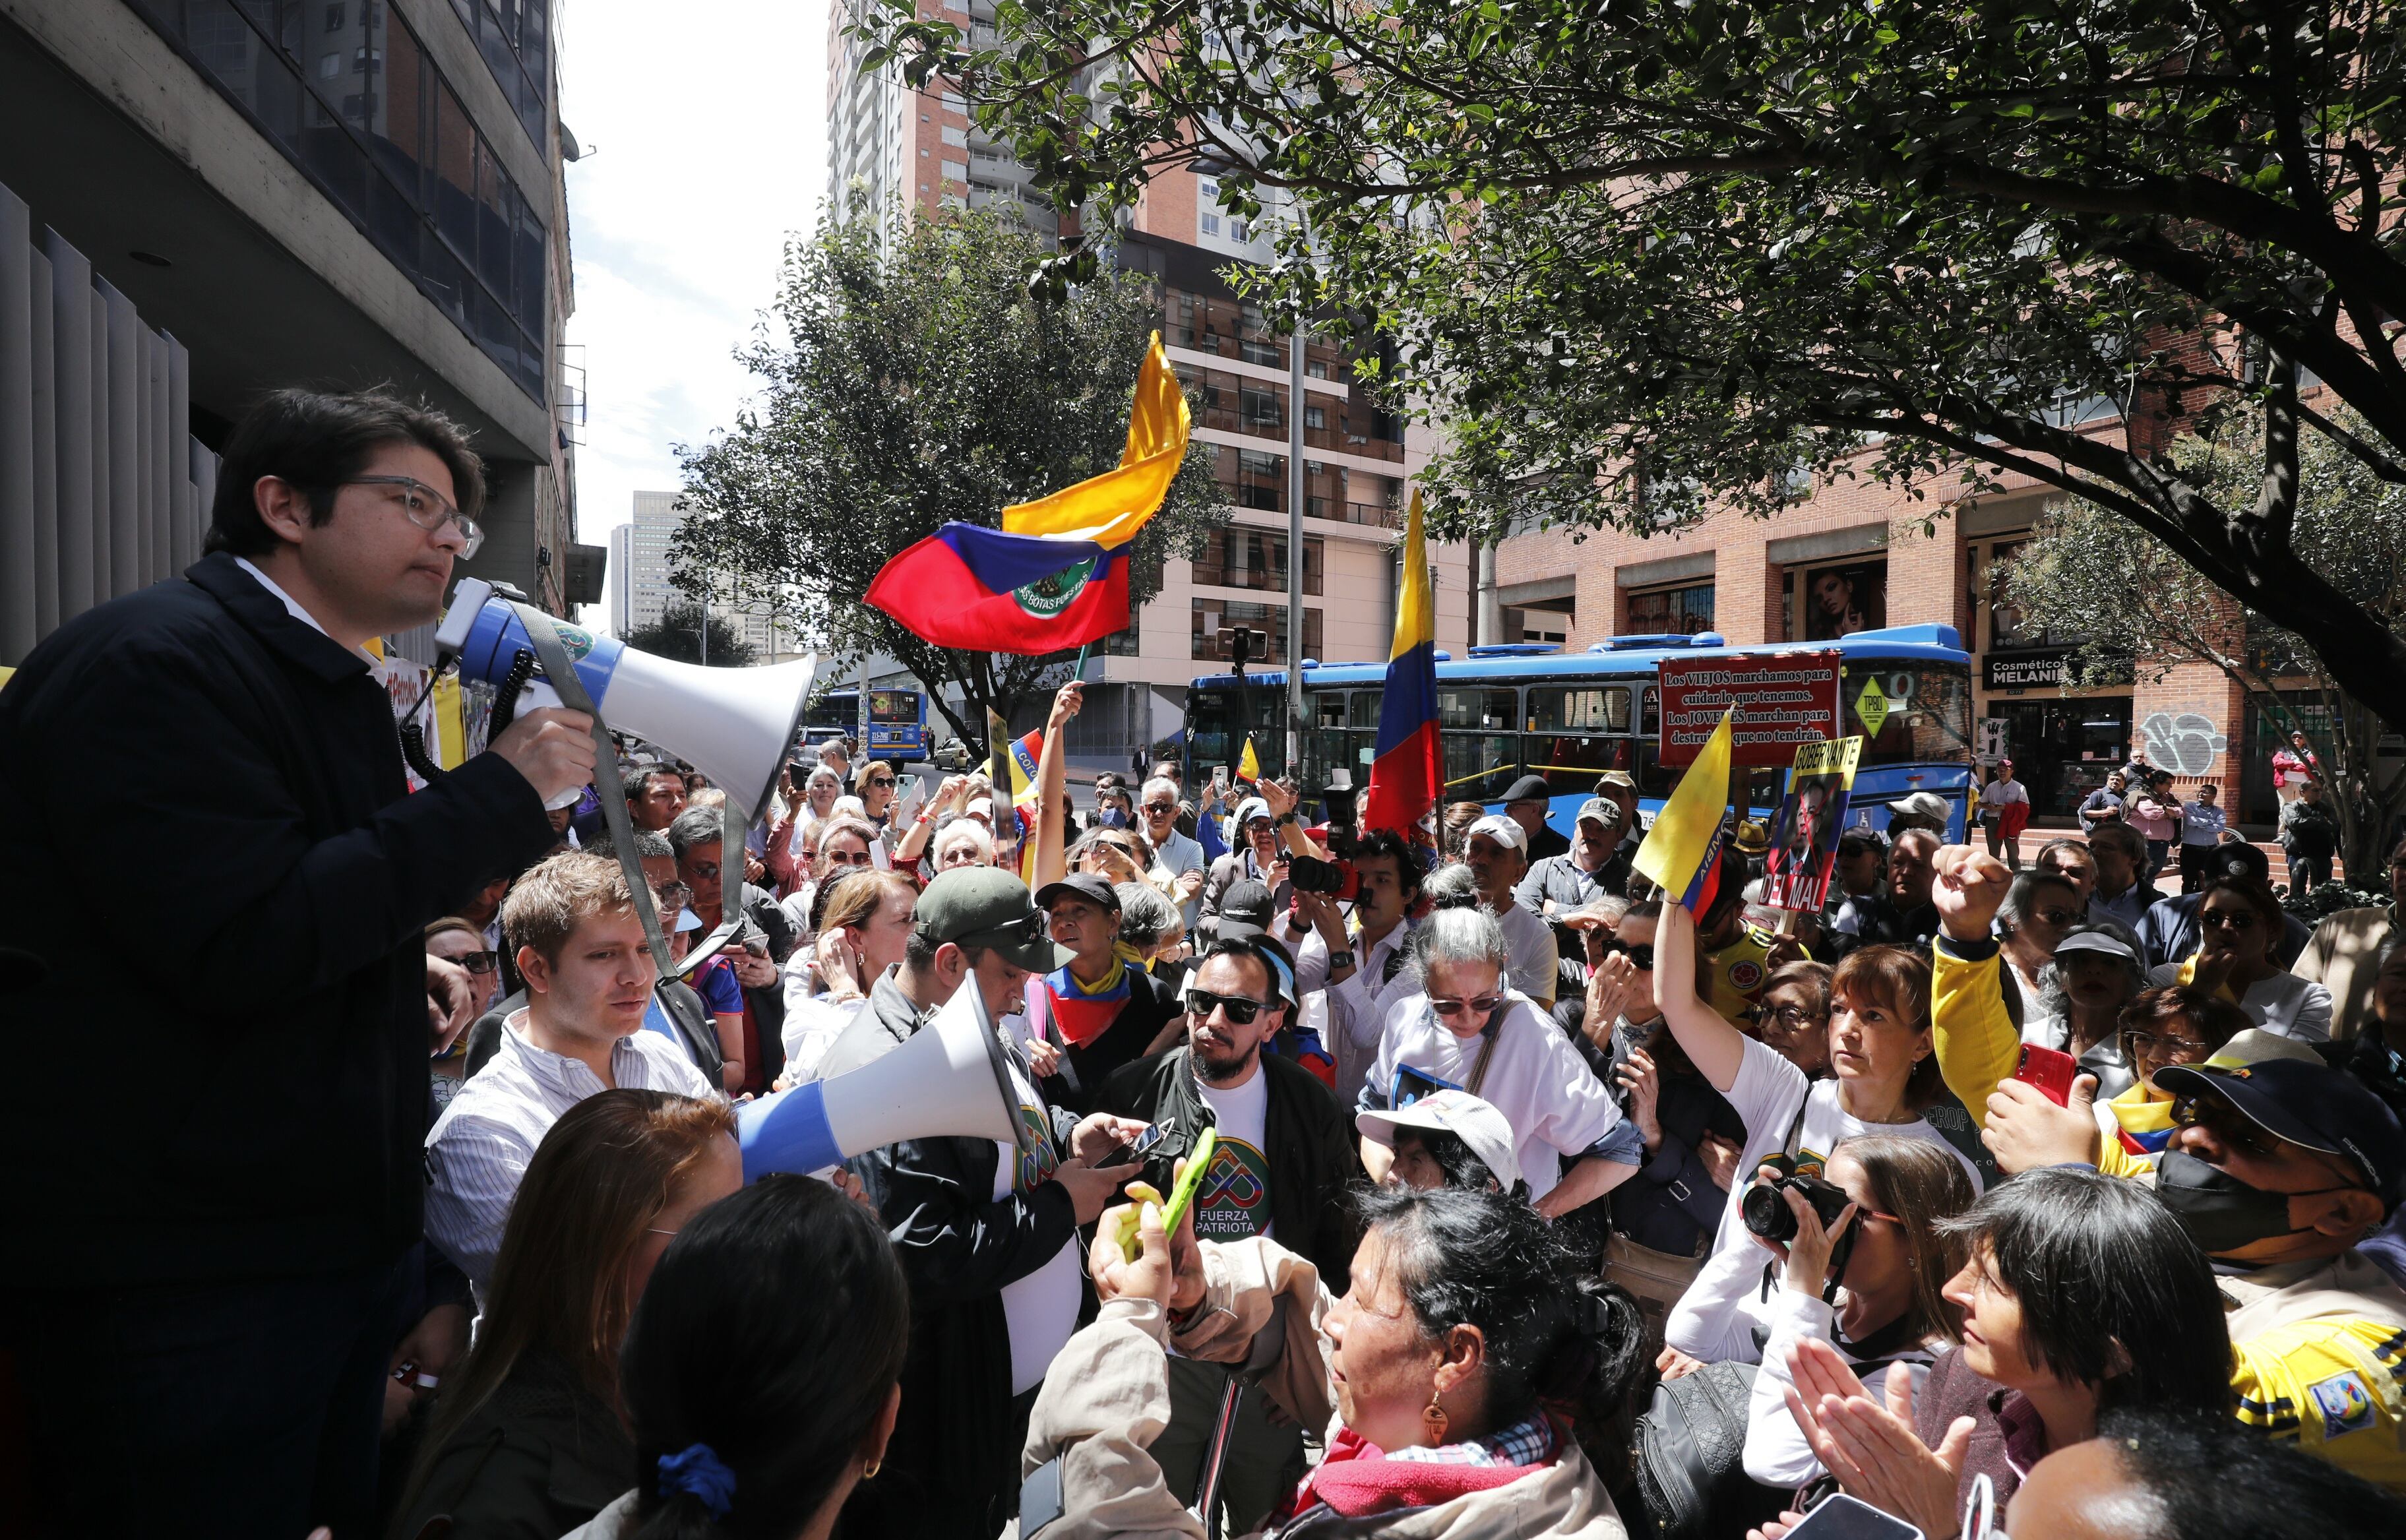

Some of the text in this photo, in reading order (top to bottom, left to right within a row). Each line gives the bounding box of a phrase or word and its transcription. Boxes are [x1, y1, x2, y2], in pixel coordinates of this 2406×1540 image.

[1029, 594, 1055, 610] BOTAS
[1055, 570, 1089, 608] PUESTAS
[1992, 660, 2068, 671] Cosméticos
[1665, 673, 1685, 687] Los
[1686, 670, 1731, 687] VIEJOS
[1732, 667, 1801, 683] marchamos
[1803, 669, 1833, 685] para
[1682, 690, 1813, 706] cuidar lo que tenemos.
[1667, 712, 1687, 725] Los
[1746, 707, 1801, 723] marchan
[1801, 710, 1830, 725] para
[1732, 734, 1755, 747] que
[1756, 732, 1772, 743] no
[1774, 727, 1826, 741] tendrán.
[1796, 738, 1859, 771] GOBERNANTE
[1585, 801, 1615, 816] ARMY
[1759, 873, 1821, 911] DEL MAL
[1796, 1178, 1809, 1189] Canon
[1200, 1211, 1250, 1221] FUERZA
[1196, 1222, 1255, 1233] PATRIOTA
